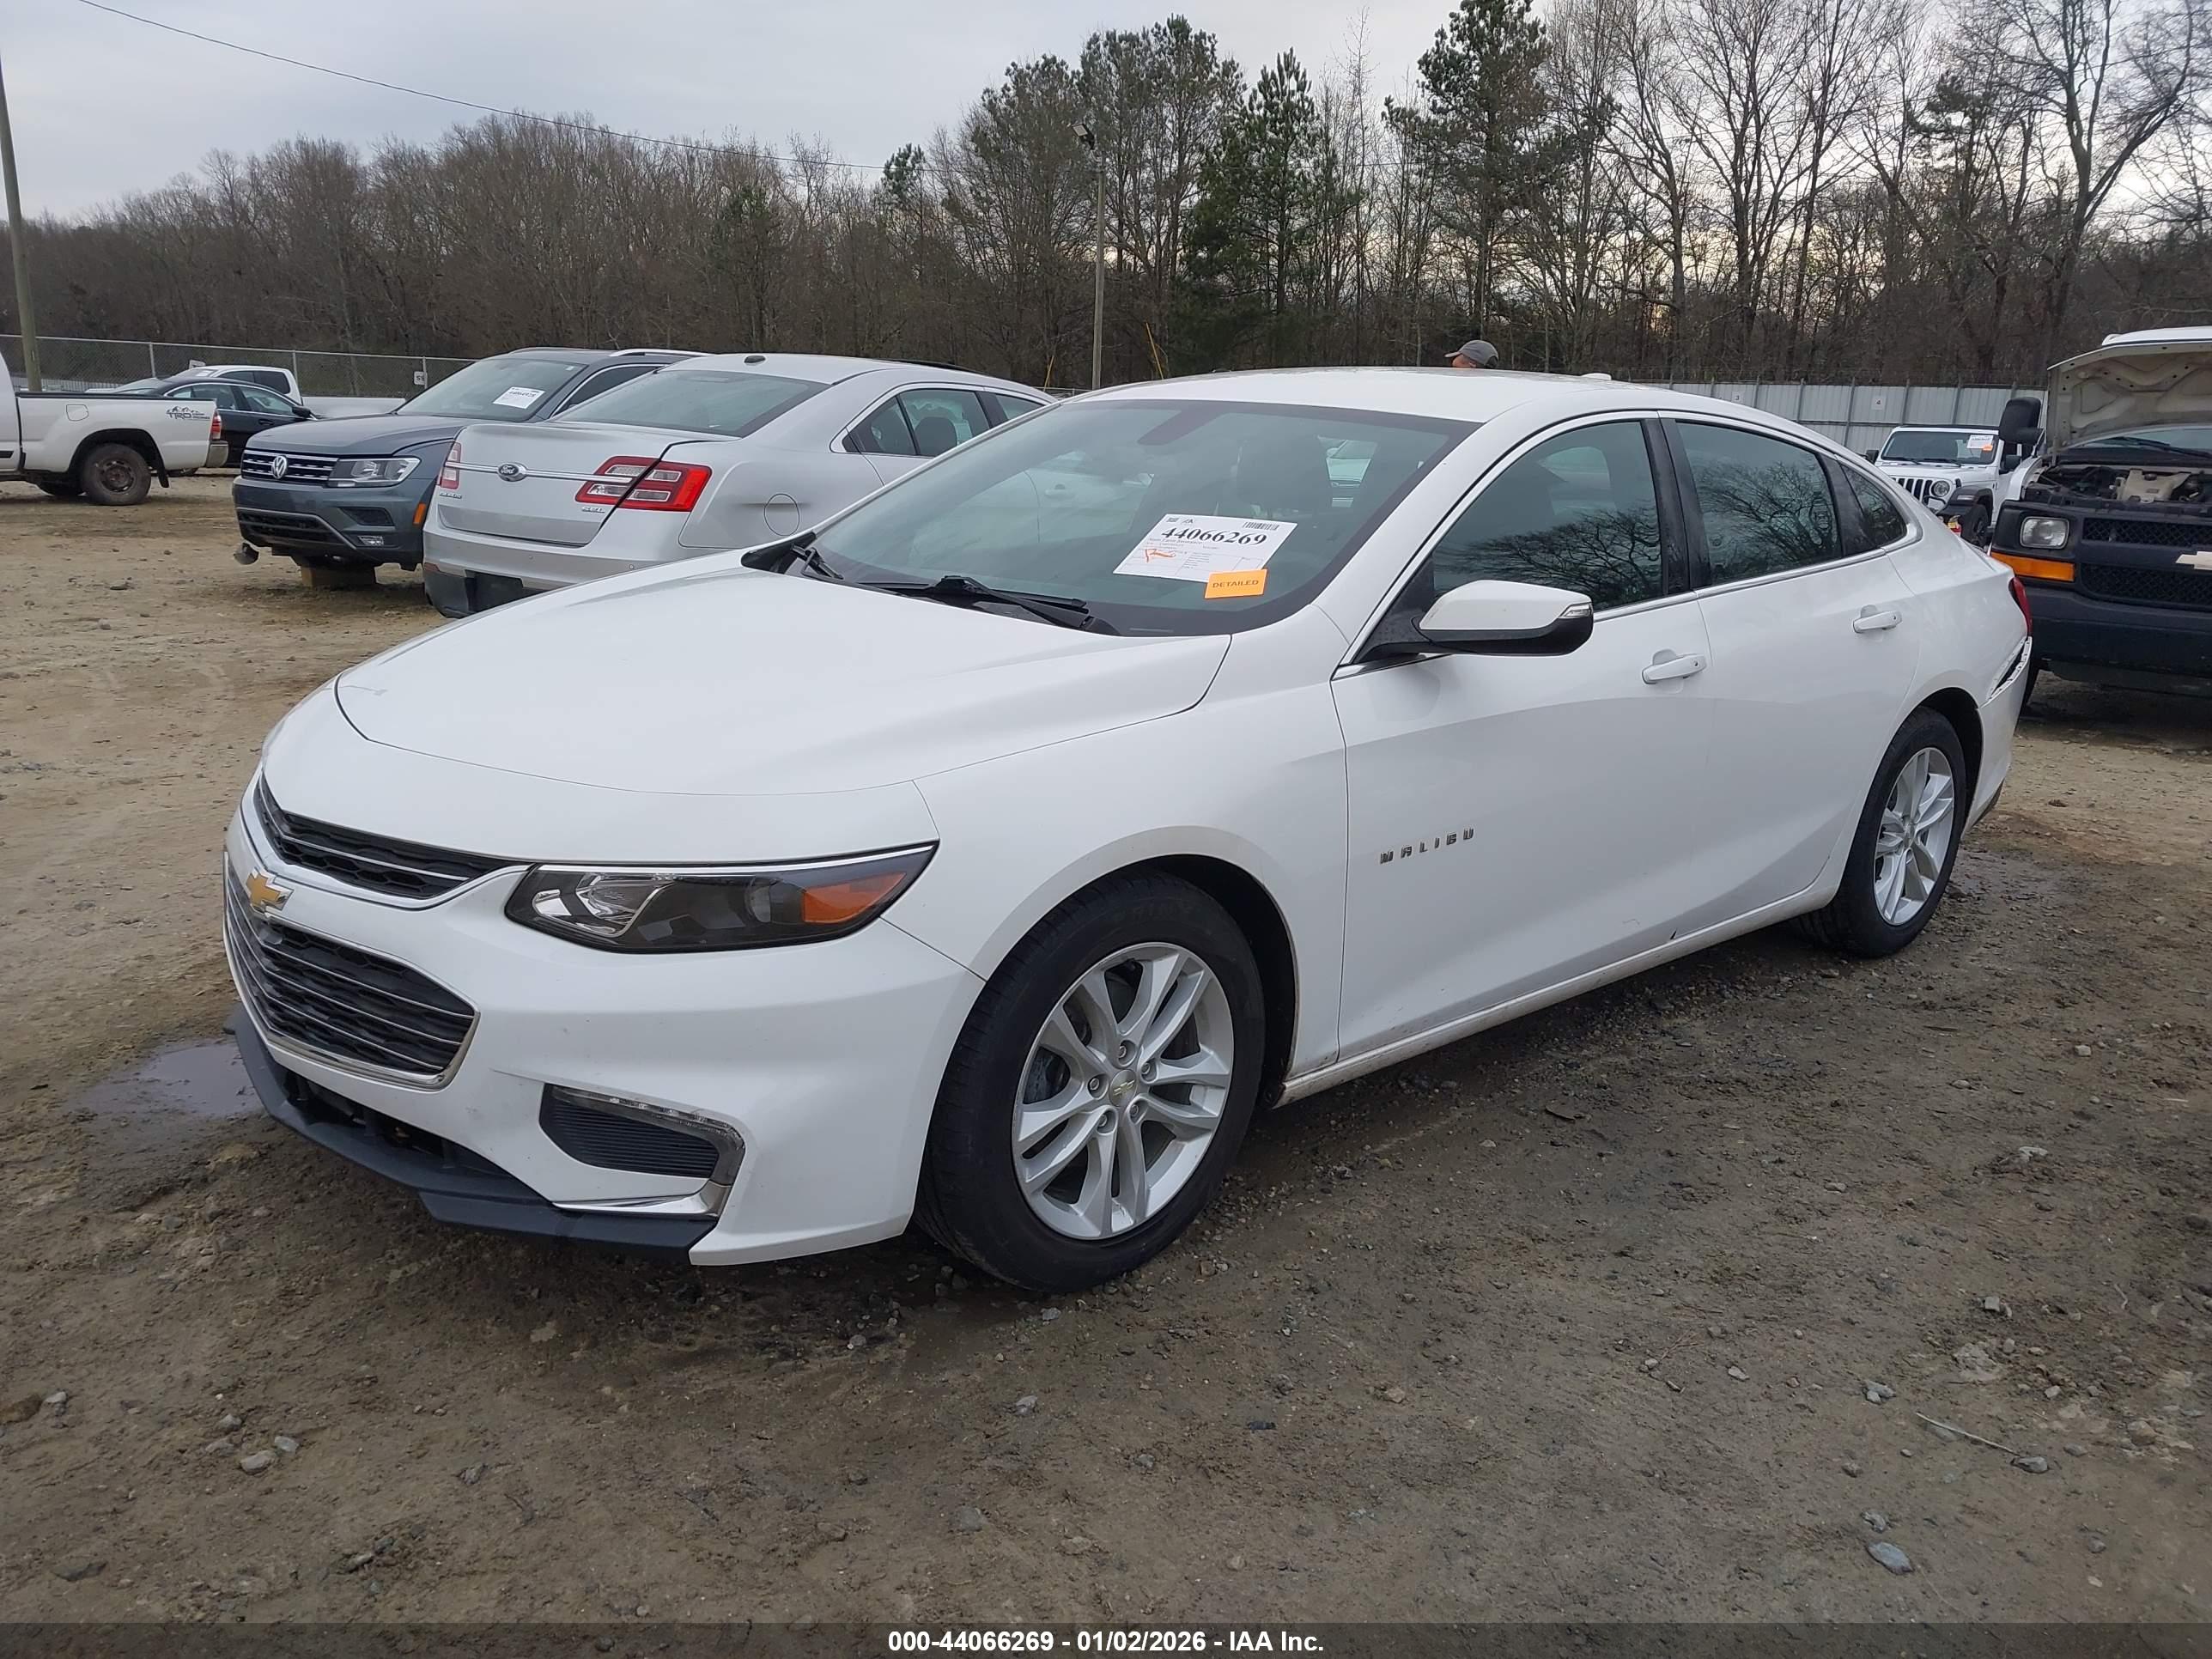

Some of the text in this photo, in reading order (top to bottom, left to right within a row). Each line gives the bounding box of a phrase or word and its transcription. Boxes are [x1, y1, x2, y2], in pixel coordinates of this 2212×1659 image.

[1161, 527, 1267, 546] 44066269
[1212, 580, 1259, 588] DETAILED
[1380, 828, 1474, 864] MALIBU
